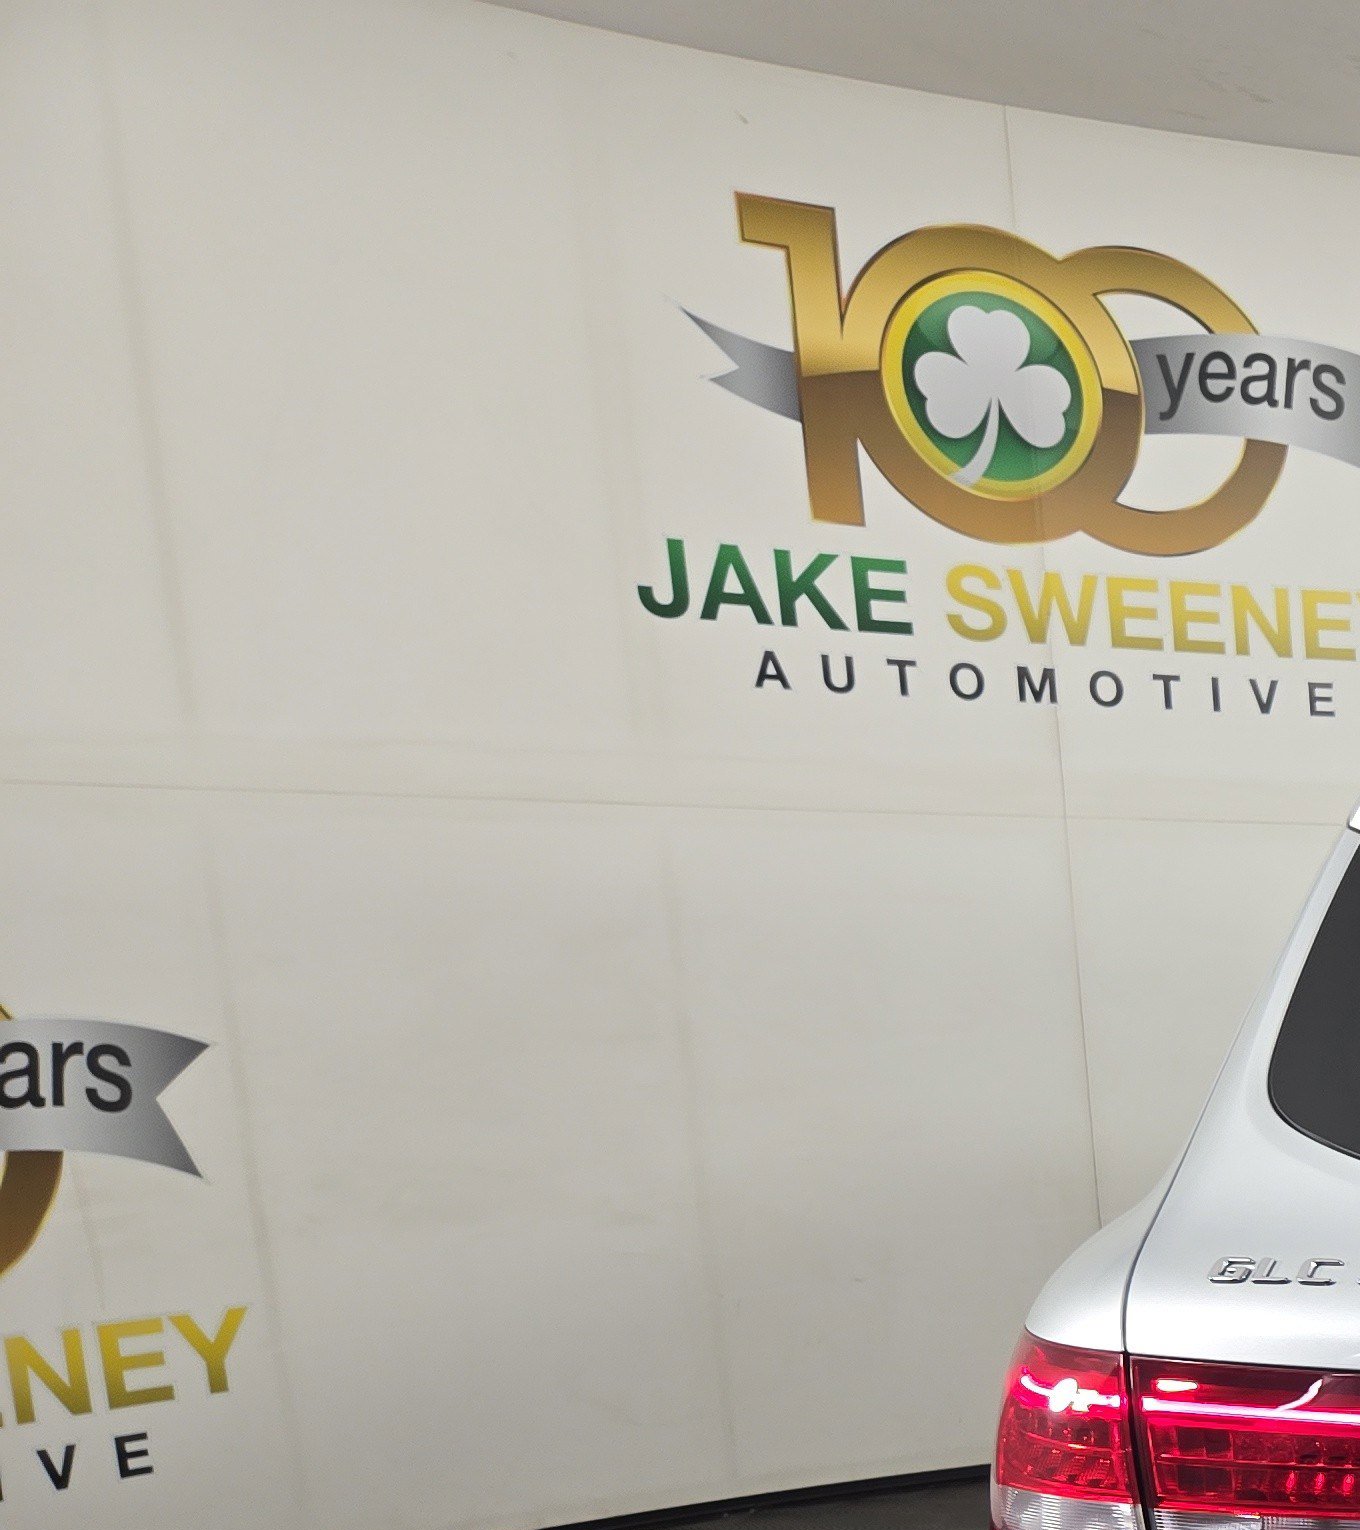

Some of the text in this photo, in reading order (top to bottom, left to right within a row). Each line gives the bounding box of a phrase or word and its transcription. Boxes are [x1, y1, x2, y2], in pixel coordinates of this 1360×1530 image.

[733, 191, 1347, 557] 100 years
[637, 537, 914, 635] JAKE
[755, 650, 1336, 717] AUTOMOTIVE
[1208, 1256, 1345, 1286] GLC
[0, 1306, 247, 1427] NEY
[0, 1431, 154, 1501] VE
